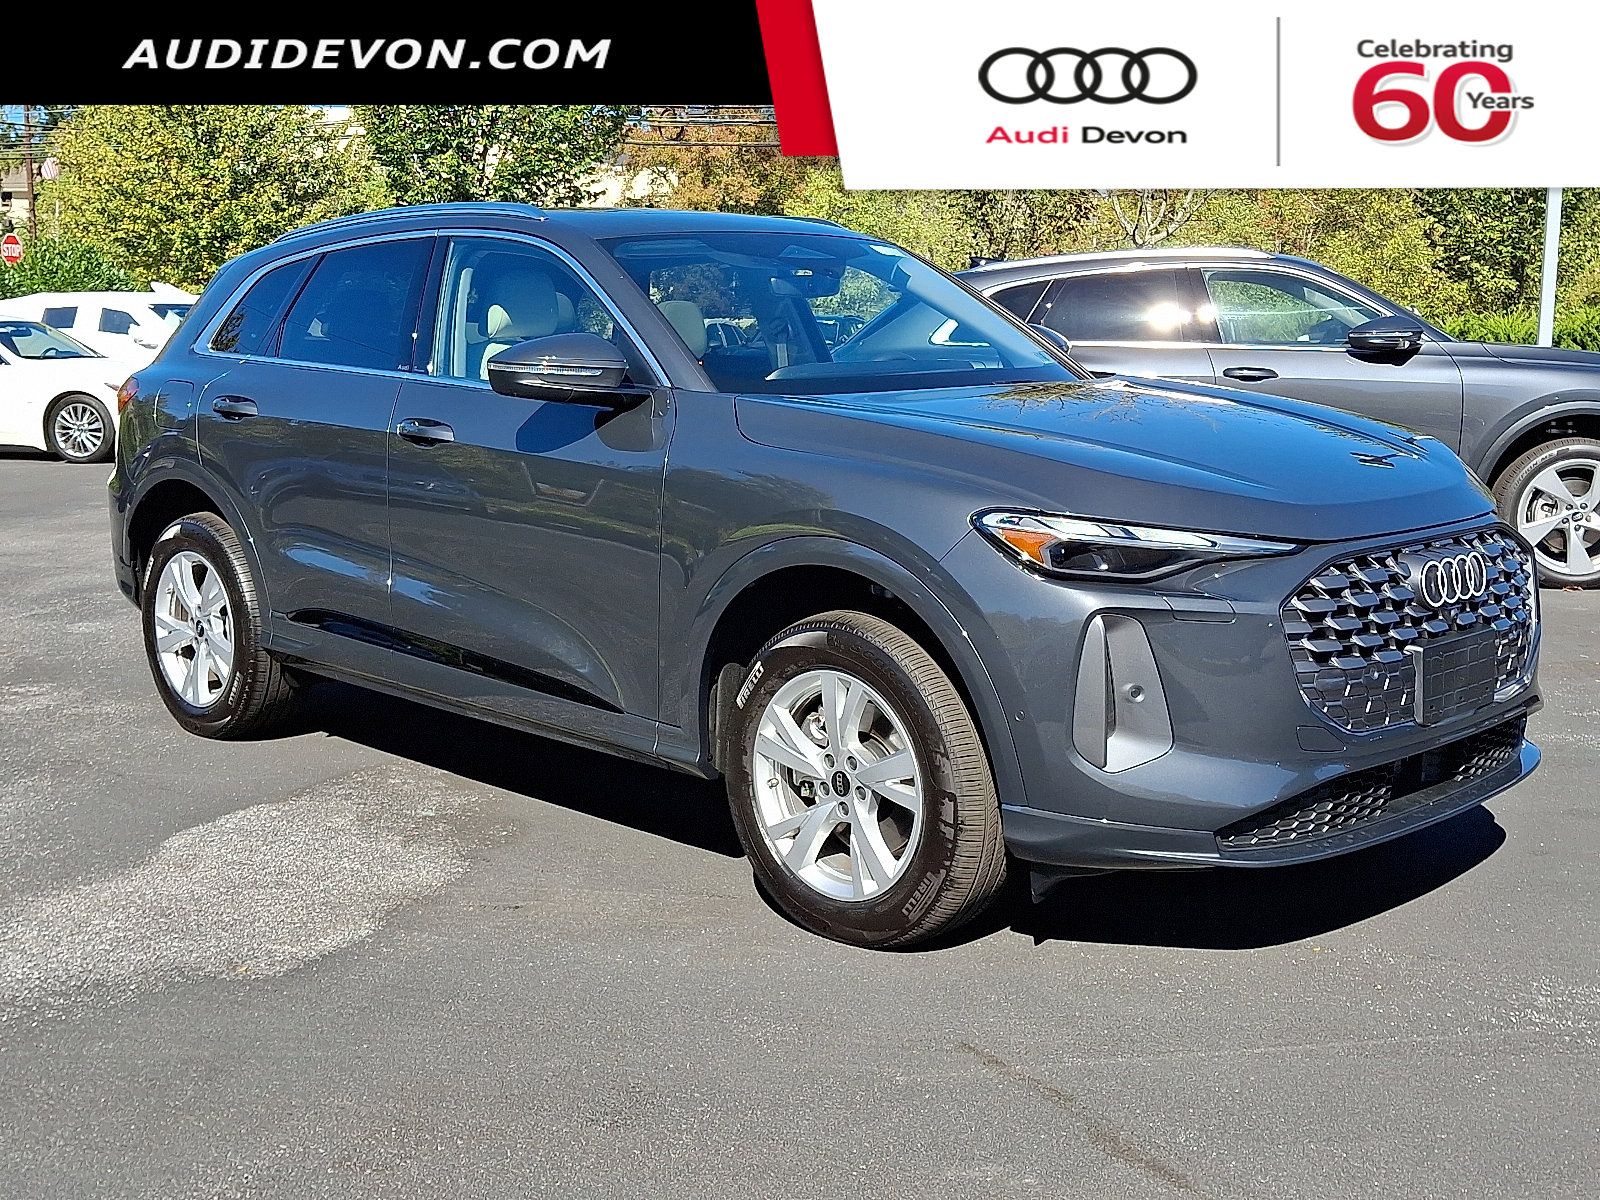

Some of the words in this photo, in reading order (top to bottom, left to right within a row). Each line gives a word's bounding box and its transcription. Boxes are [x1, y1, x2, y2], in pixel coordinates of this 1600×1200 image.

[3, 244, 21, 257] STOP
[735, 660, 765, 710] PIRELLI
[901, 869, 946, 920] PIRELLI
